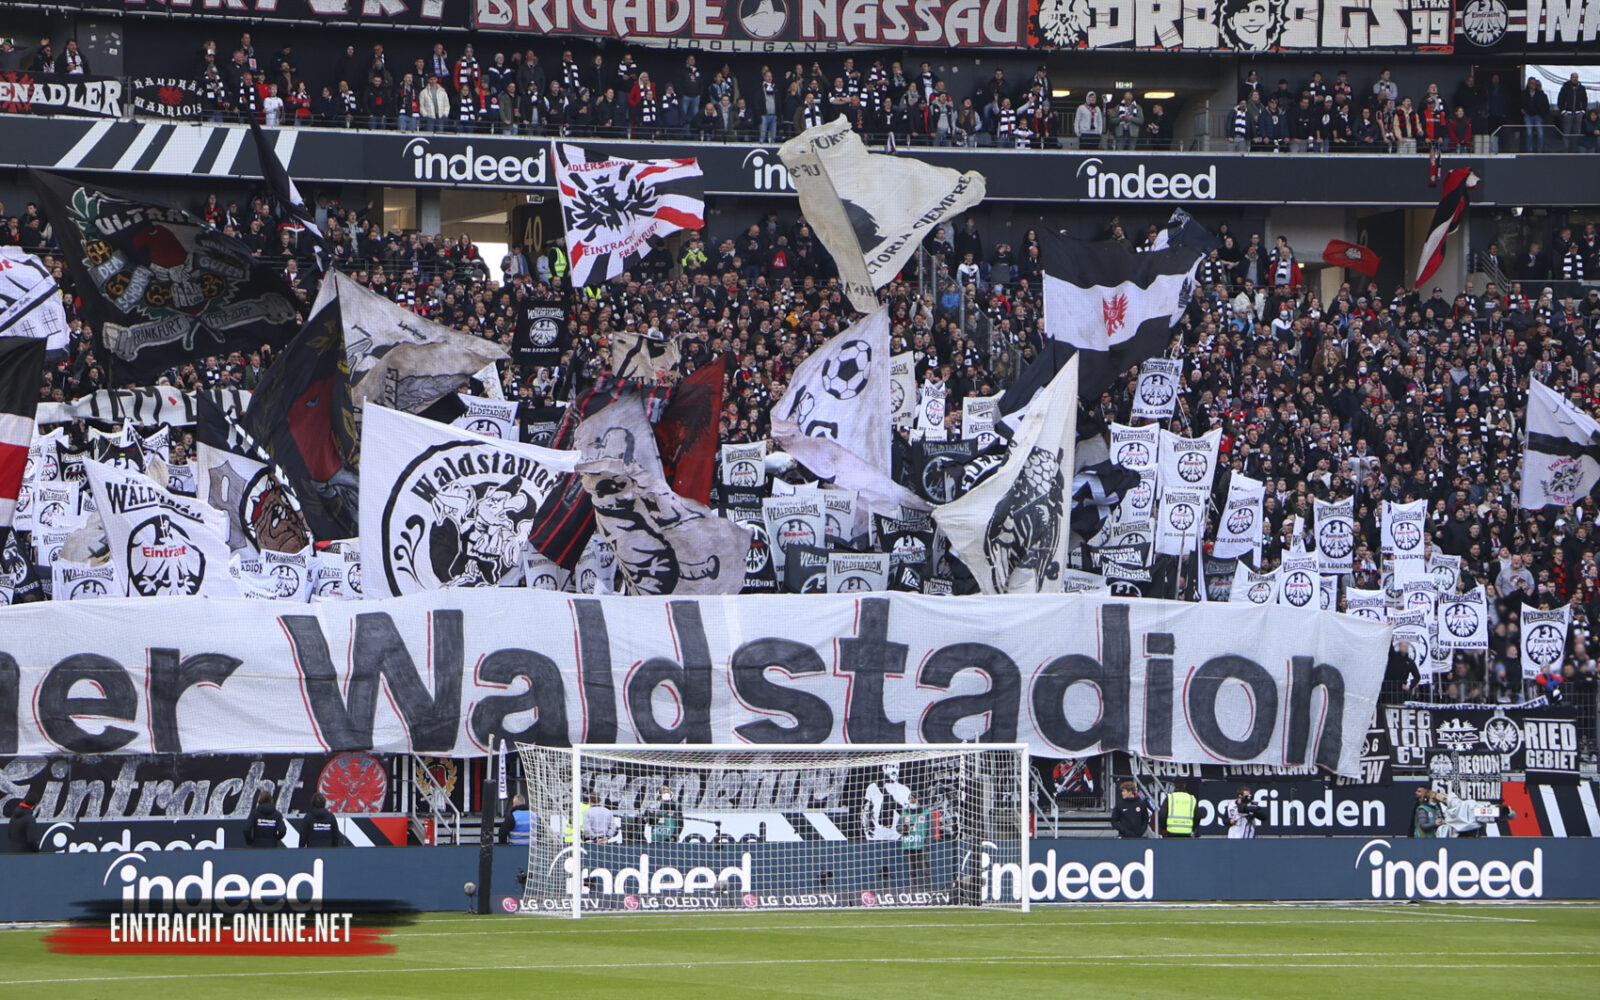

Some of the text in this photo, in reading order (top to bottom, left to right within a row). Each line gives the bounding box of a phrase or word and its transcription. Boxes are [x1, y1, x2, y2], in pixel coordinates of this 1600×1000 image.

[475, 0, 729, 38] BRIGADE
[801, 0, 1018, 46] NASSAU
[1471, 11, 1501, 19] Eintracht
[1411, 10, 1449, 45] 99
[404, 138, 546, 183] indeed
[1077, 158, 1217, 199] indeed
[913, 175, 972, 229] SIEMPRE
[525, 216, 543, 252] 40
[464, 407, 512, 423] ALDSTADION
[766, 504, 820, 521] WALDSTADION
[832, 559, 884, 576] WALDSTADION
[1440, 640, 1488, 648] DIE LEGENDE
[276, 597, 1346, 780] Waldstadion
[1385, 708, 1431, 729] REG
[1524, 722, 1578, 751] RIED
[1397, 746, 1426, 765] 64
[1458, 754, 1500, 775] REGION
[1525, 749, 1579, 770] GEBIET
[1459, 780, 1501, 801] WETTERAU
[549, 846, 752, 895] indeed
[962, 841, 1154, 900] indeed
[1355, 839, 1543, 899] indeed
[104, 853, 324, 913] indeed
[520, 899, 538, 910] LG
[581, 898, 600, 909] TV
[641, 897, 719, 909] LG OLED TV
[760, 894, 837, 907] LG OLED TV
[877, 893, 895, 905] LG
[900, 893, 932, 904] OLED
